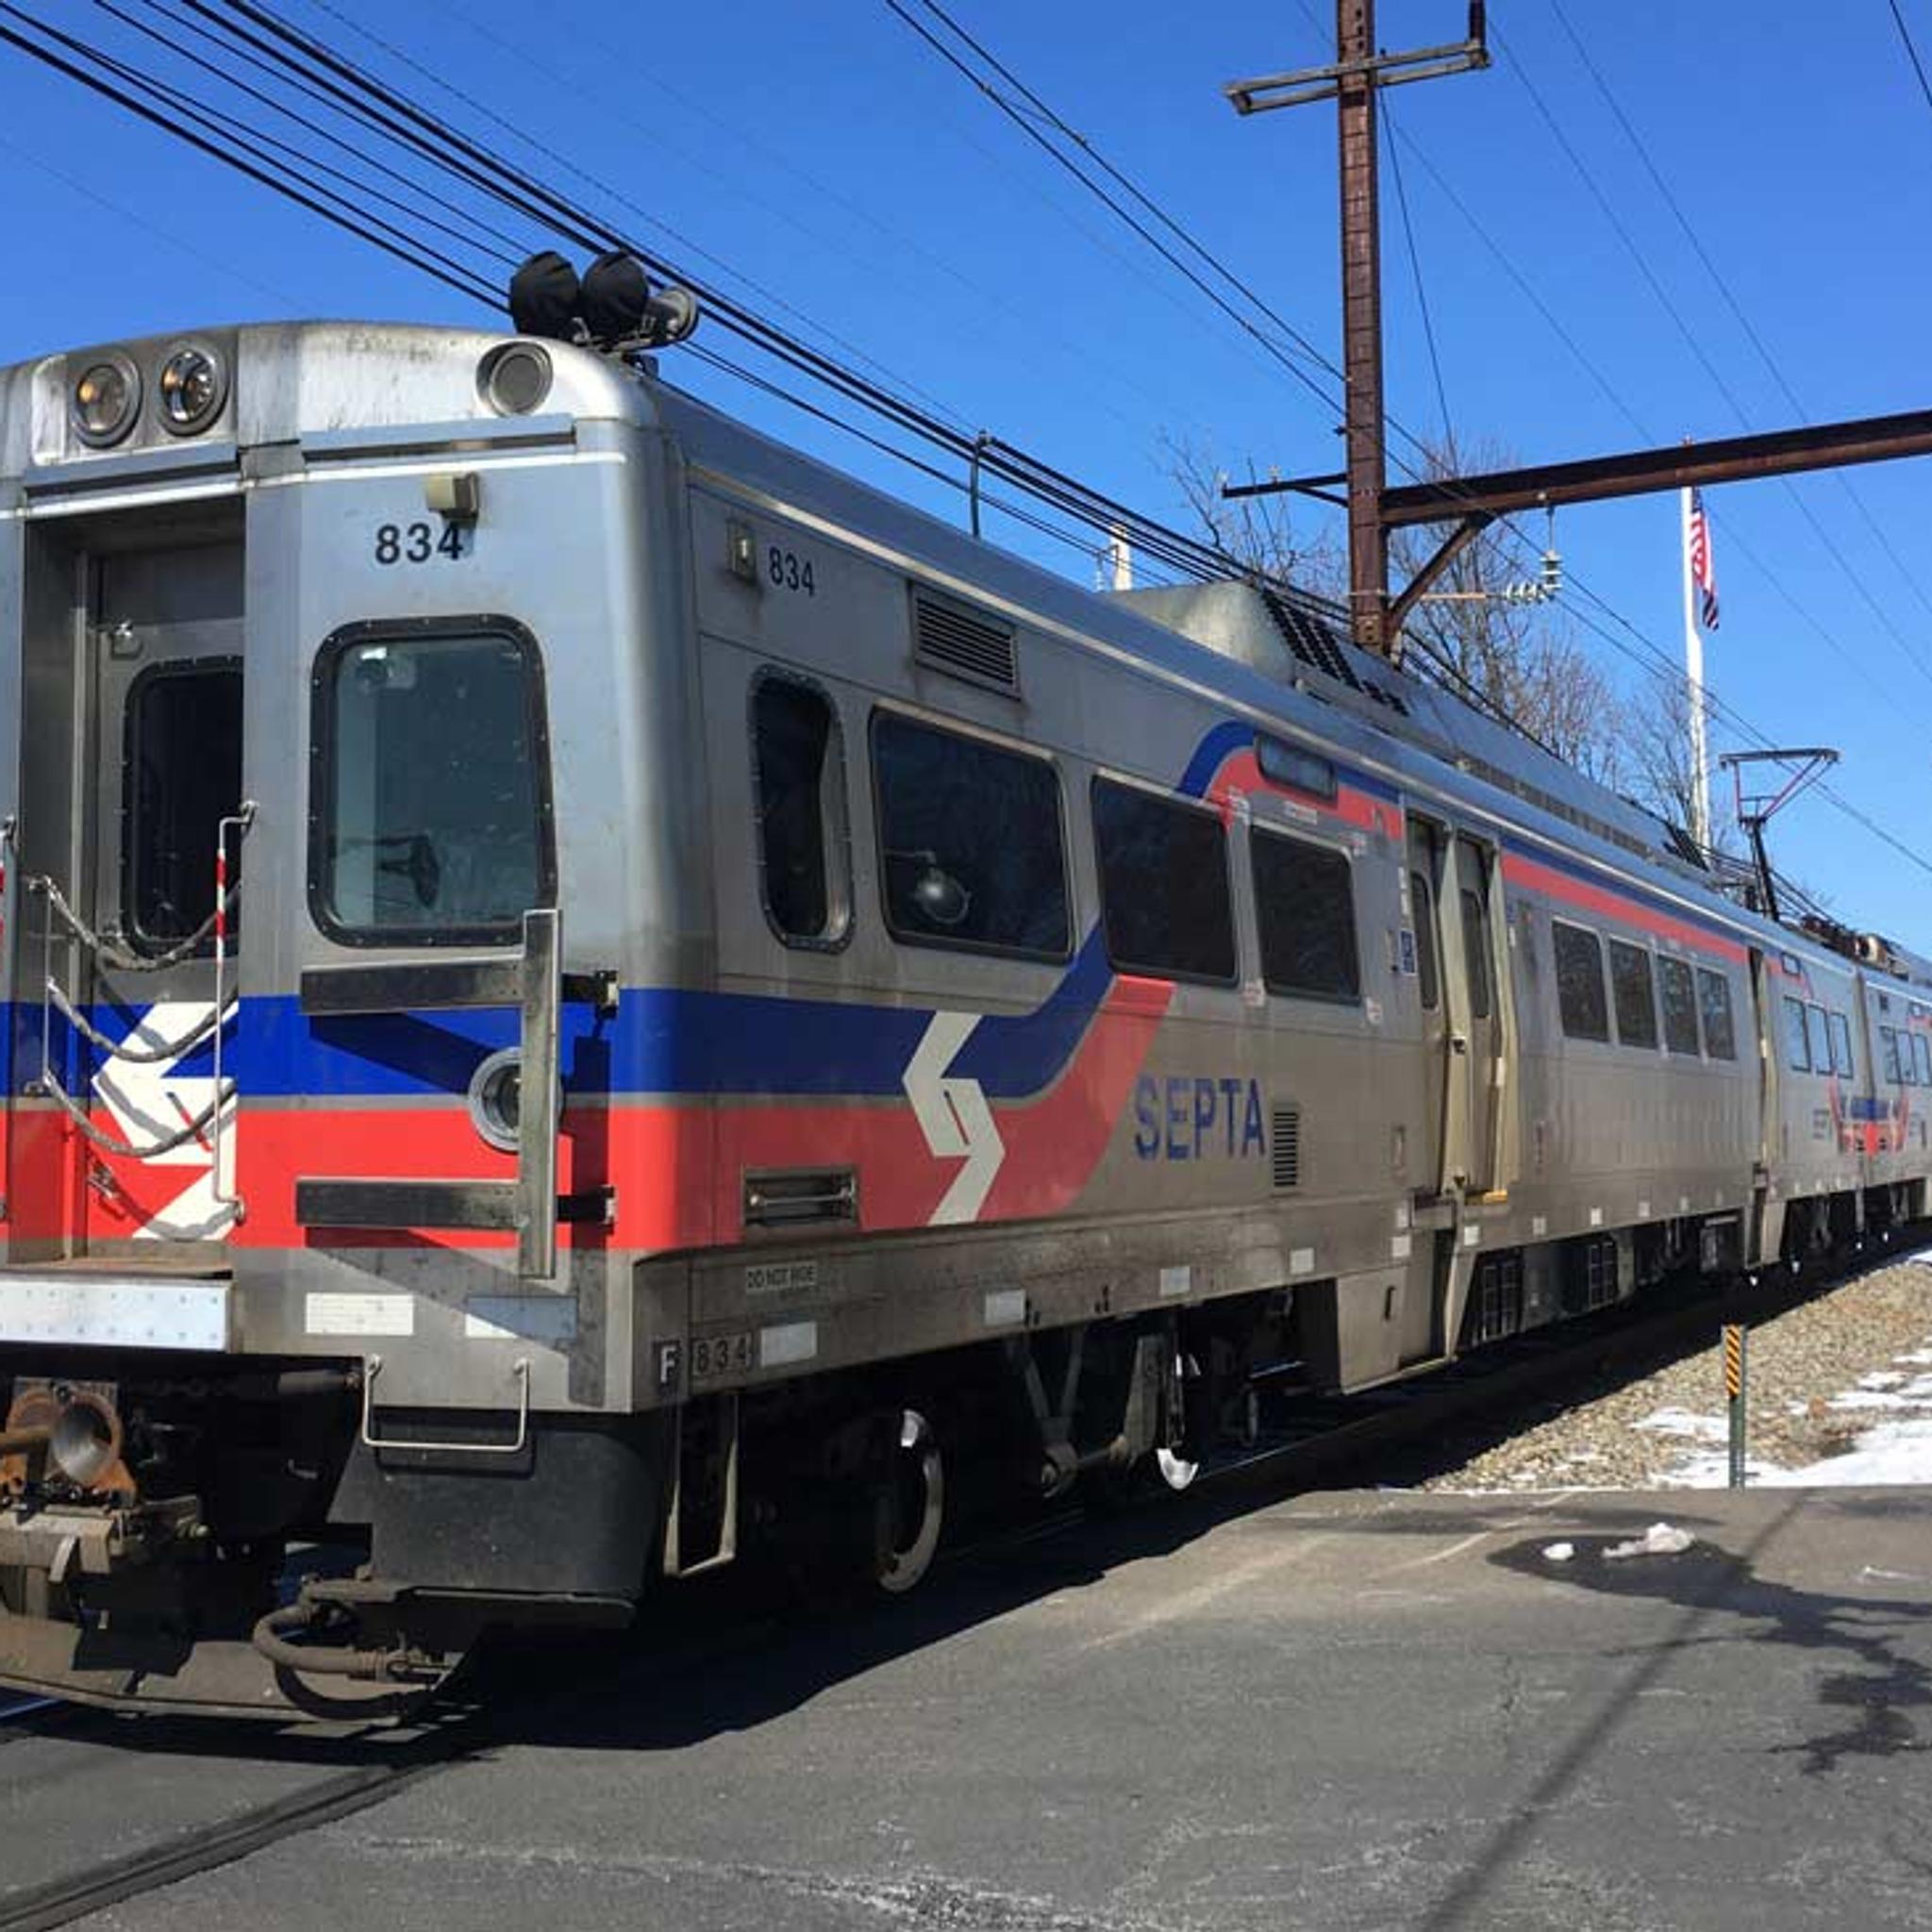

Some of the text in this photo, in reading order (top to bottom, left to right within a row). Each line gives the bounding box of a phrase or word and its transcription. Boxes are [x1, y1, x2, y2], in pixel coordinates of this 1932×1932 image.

[375, 522, 465, 565] 834
[769, 547, 816, 596] 834
[1135, 1074, 1266, 1160] SEPTA
[659, 1344, 678, 1384] F
[696, 1336, 747, 1374] 834
